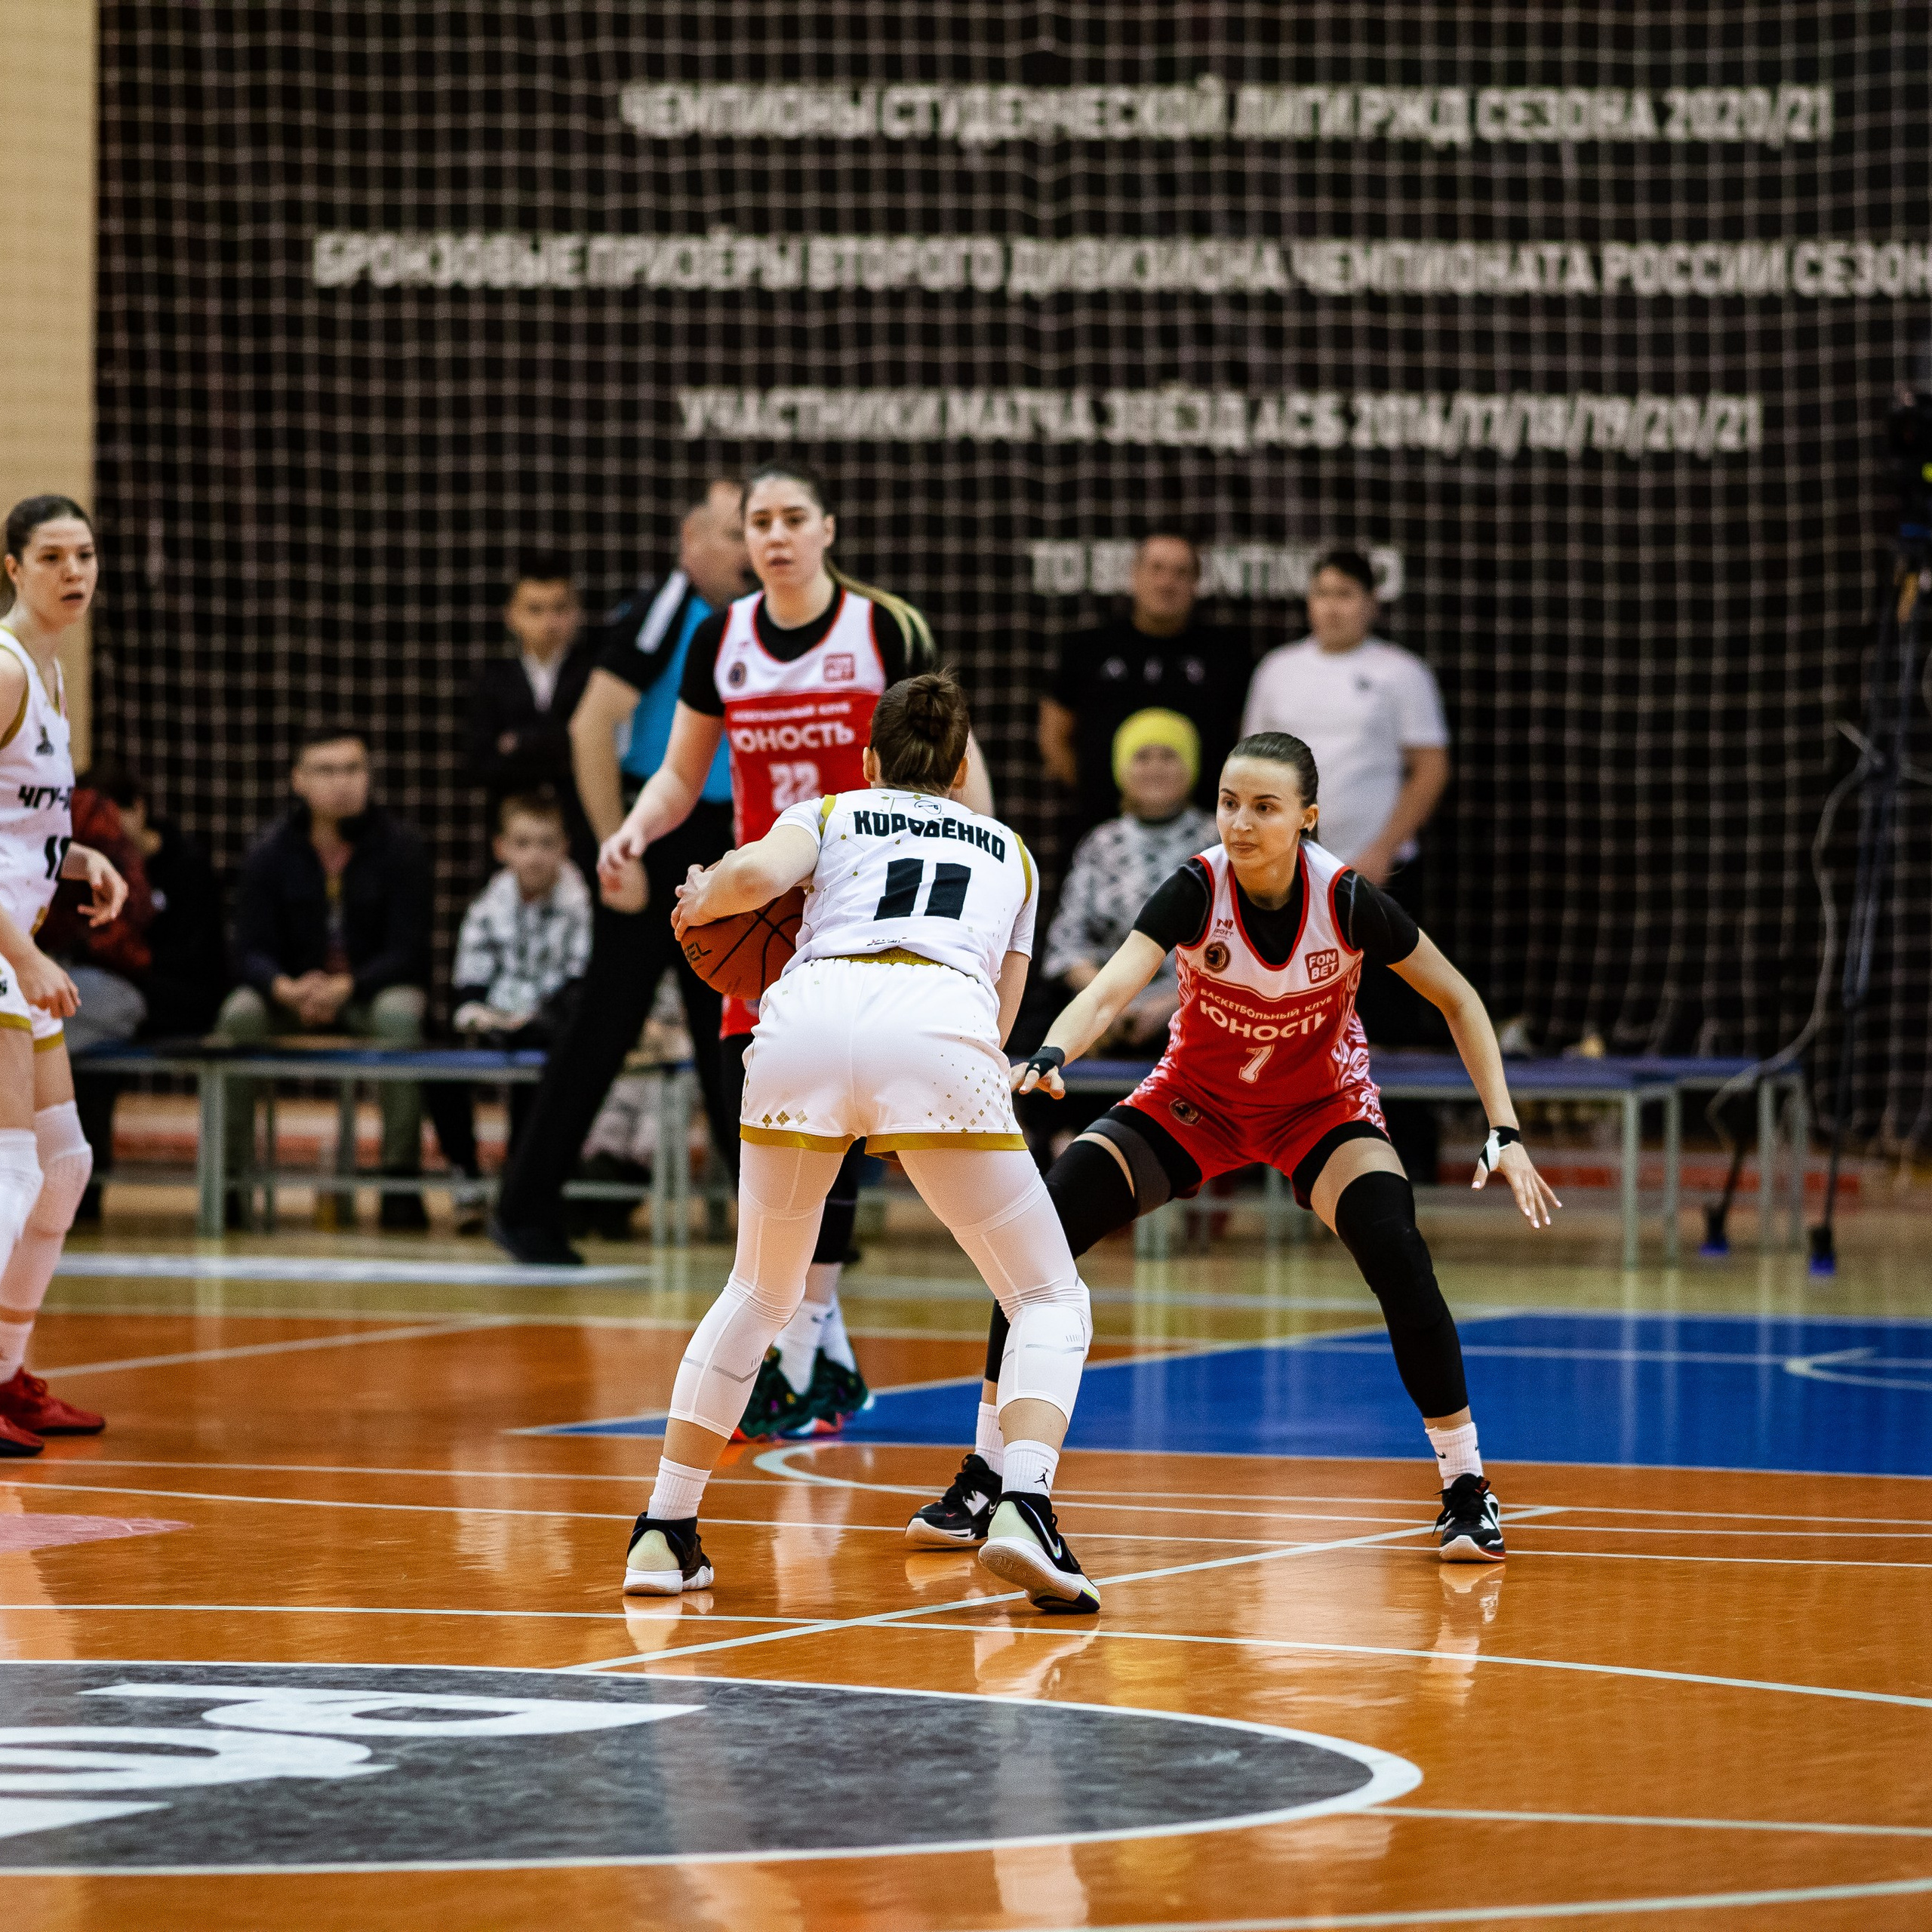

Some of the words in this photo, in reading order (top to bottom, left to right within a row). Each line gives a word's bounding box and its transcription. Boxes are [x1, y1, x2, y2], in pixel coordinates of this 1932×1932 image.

[1359, 85, 1472, 147] РЖД
[1477, 85, 1658, 142] СЕЗОНА
[1665, 86, 1833, 146] 2020/21
[768, 760, 821, 813] 22
[873, 857, 971, 921] 11
[1309, 952, 1336, 968] FON
[1311, 961, 1338, 980] BET
[1200, 988, 1300, 1020] БАСКЕТБОЛЬНЫЙ
[1304, 995, 1333, 1013] КЛУБ
[1238, 1044, 1275, 1084] 7
